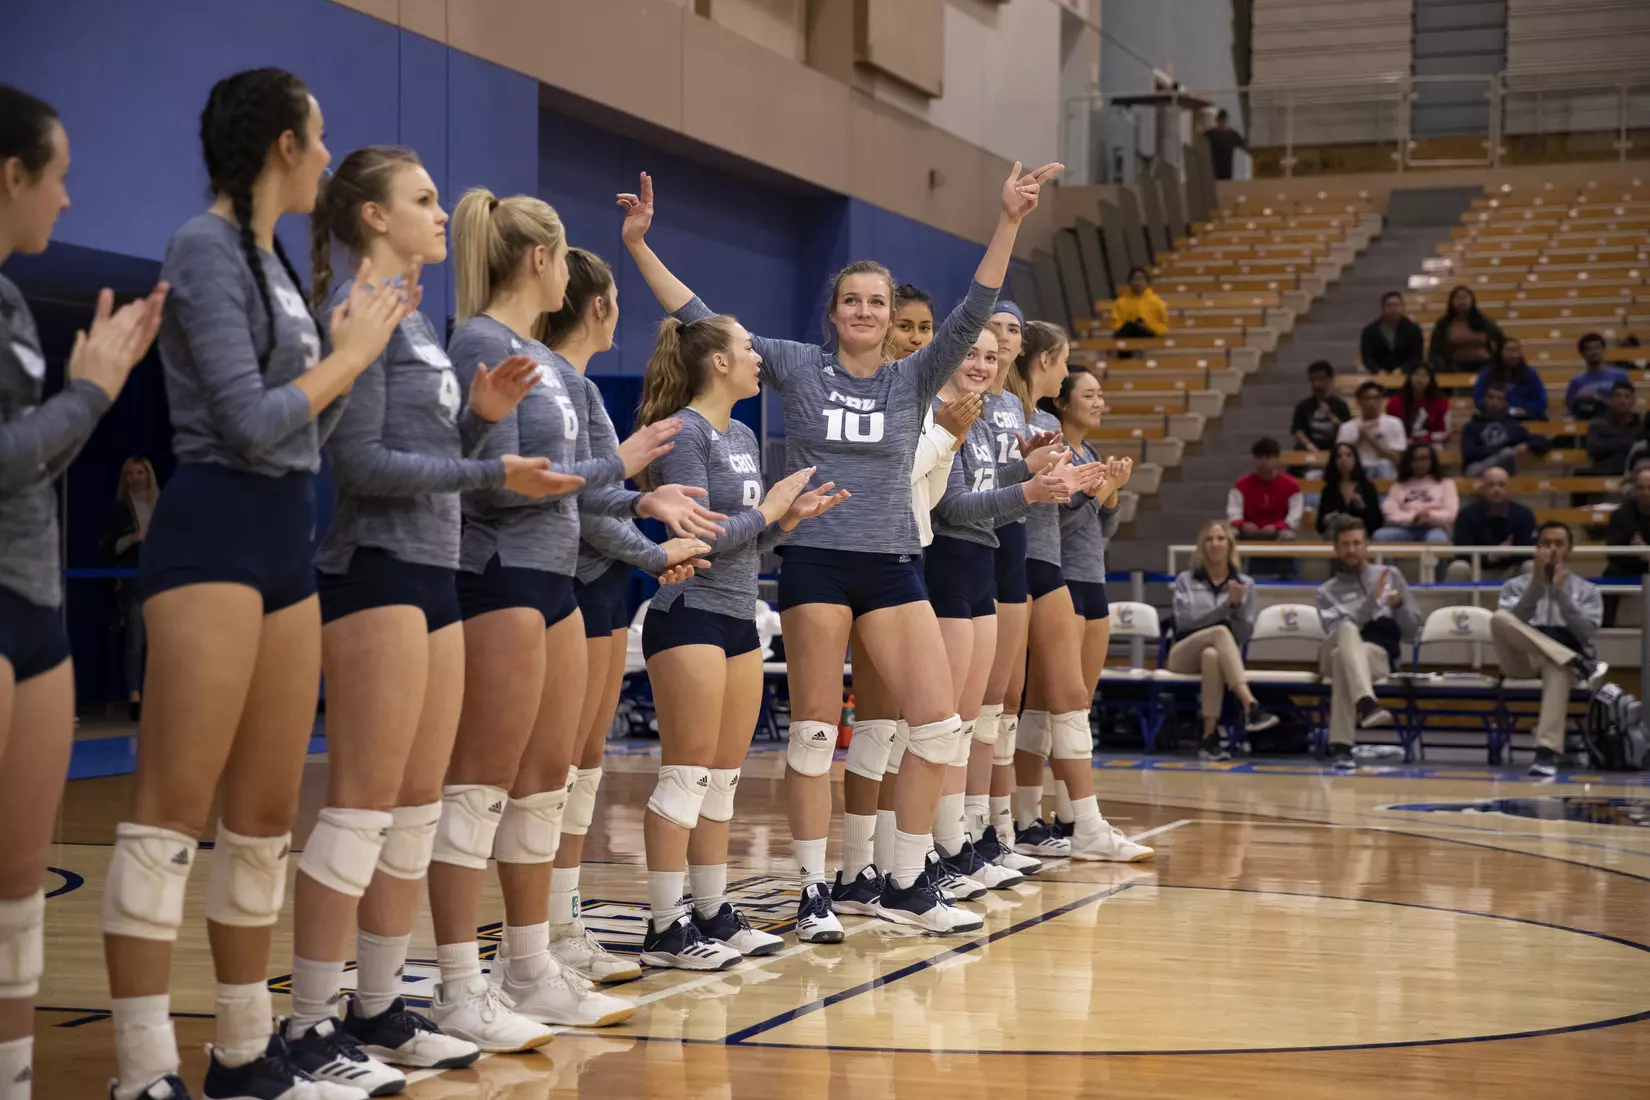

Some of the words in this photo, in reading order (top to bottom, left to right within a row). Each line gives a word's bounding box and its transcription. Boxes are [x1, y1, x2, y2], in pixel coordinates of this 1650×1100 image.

[822, 408, 884, 442] 10
[993, 411, 1019, 429] CBU
[728, 453, 757, 474] CBU
[742, 480, 761, 509] 9
